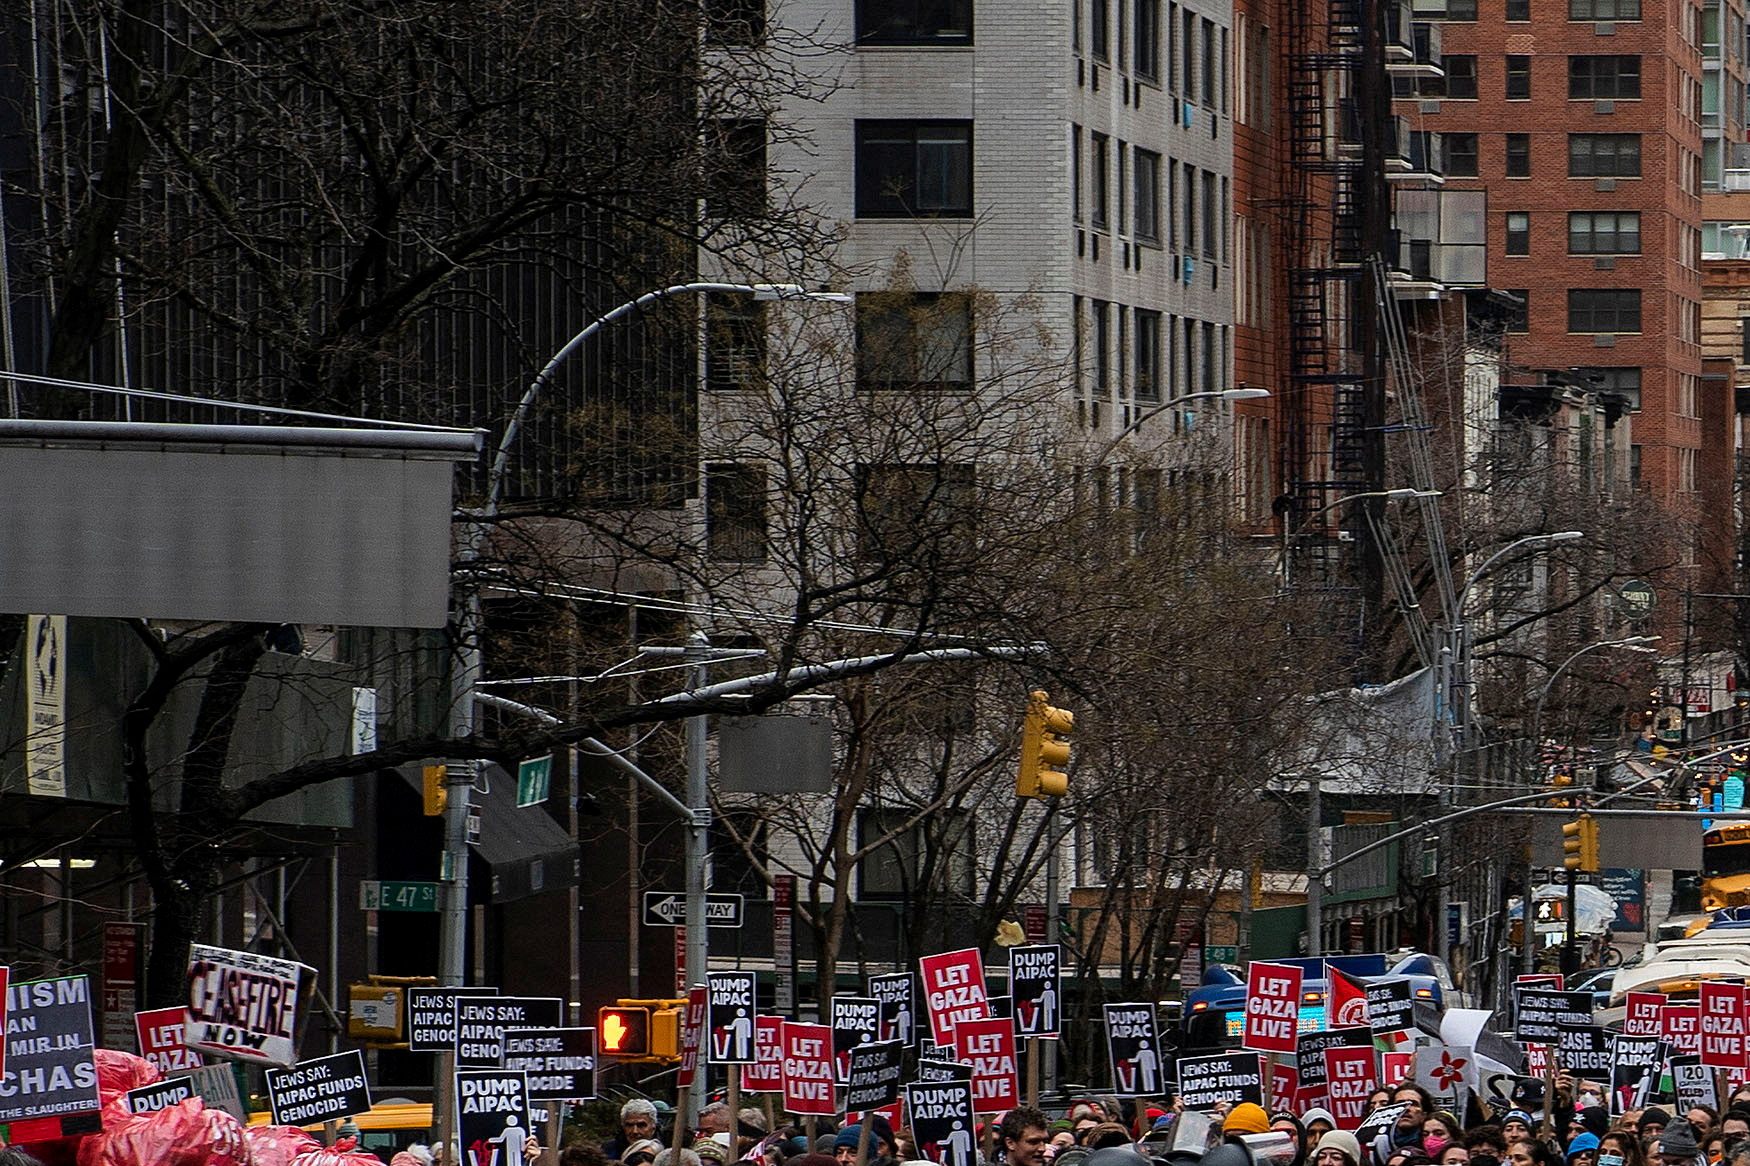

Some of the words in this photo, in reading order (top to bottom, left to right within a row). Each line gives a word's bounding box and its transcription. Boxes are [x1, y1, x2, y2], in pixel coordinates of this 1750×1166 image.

[382, 887, 390, 907] E
[396, 887, 418, 907] 47
[660, 903, 687, 916] ONE
[705, 904, 732, 917] WAY
[1014, 952, 1056, 967] DUMP
[935, 964, 970, 988] LET
[1014, 965, 1056, 980] AIPAC
[710, 979, 751, 992] DUMP
[873, 979, 910, 993] DUMP
[1259, 976, 1291, 998] LET
[413, 995, 444, 1009] JEWS
[711, 992, 751, 1006] AIPAC
[930, 985, 986, 1011] GAZA
[1708, 996, 1737, 1014] LET
[460, 1006, 495, 1021] JEWS
[497, 1007, 526, 1021] SAY:
[835, 1003, 877, 1018] DUMP
[1108, 1010, 1151, 1025] DUMP
[1249, 997, 1297, 1020] GAZA
[1518, 1010, 1555, 1022] AIPAC
[1635, 1003, 1658, 1018] LET
[413, 1013, 452, 1025] AIPAC
[835, 1017, 876, 1031] AIPAC
[938, 1007, 983, 1032] LIVE
[1627, 1019, 1661, 1034] GAZA
[1670, 1017, 1697, 1032] LET
[1702, 1015, 1744, 1035] GAZA
[149, 1024, 184, 1048] LET
[204, 1024, 268, 1049] NOW
[460, 1025, 504, 1039] AIPAC
[1111, 1023, 1153, 1038] AIPAC
[1251, 1018, 1291, 1040] LIVE
[506, 1038, 535, 1052] JEWS
[792, 1037, 823, 1058] LET
[967, 1034, 1003, 1054] LET
[1618, 1041, 1658, 1054] DUMP
[1706, 1036, 1741, 1055] LIVE
[144, 1049, 202, 1074] GAZA
[506, 1057, 544, 1071] AIPAC
[546, 1056, 593, 1070] FUNDS
[785, 1058, 832, 1080] GAZA
[1182, 1063, 1209, 1078] JEWS
[1210, 1060, 1232, 1074] SAY:
[1336, 1060, 1366, 1078] LET
[1566, 1051, 1608, 1069] SIEGE
[273, 1071, 305, 1090] JEWS
[306, 1064, 332, 1080] SAY:
[749, 1064, 780, 1080] LIVE
[1682, 1066, 1705, 1080] 120
[277, 1086, 316, 1107] AIPAC
[317, 1075, 364, 1097] FUNDS
[461, 1079, 522, 1097] DUMP
[789, 1082, 830, 1101] LIVE
[1182, 1077, 1217, 1092] AIPAC
[1218, 1073, 1259, 1089] FUNDS
[1330, 1079, 1376, 1098] GAZA
[134, 1086, 188, 1113] DUMP
[462, 1095, 523, 1114] AIPAC
[912, 1087, 967, 1105] DUMP
[1182, 1089, 1243, 1106] GENOCIDE
[1, 1107, 22, 1119] THE
[25, 1099, 99, 1117] SLAUGHTER!
[280, 1096, 348, 1123] GENOCIDE
[914, 1102, 968, 1119] AIPAC
